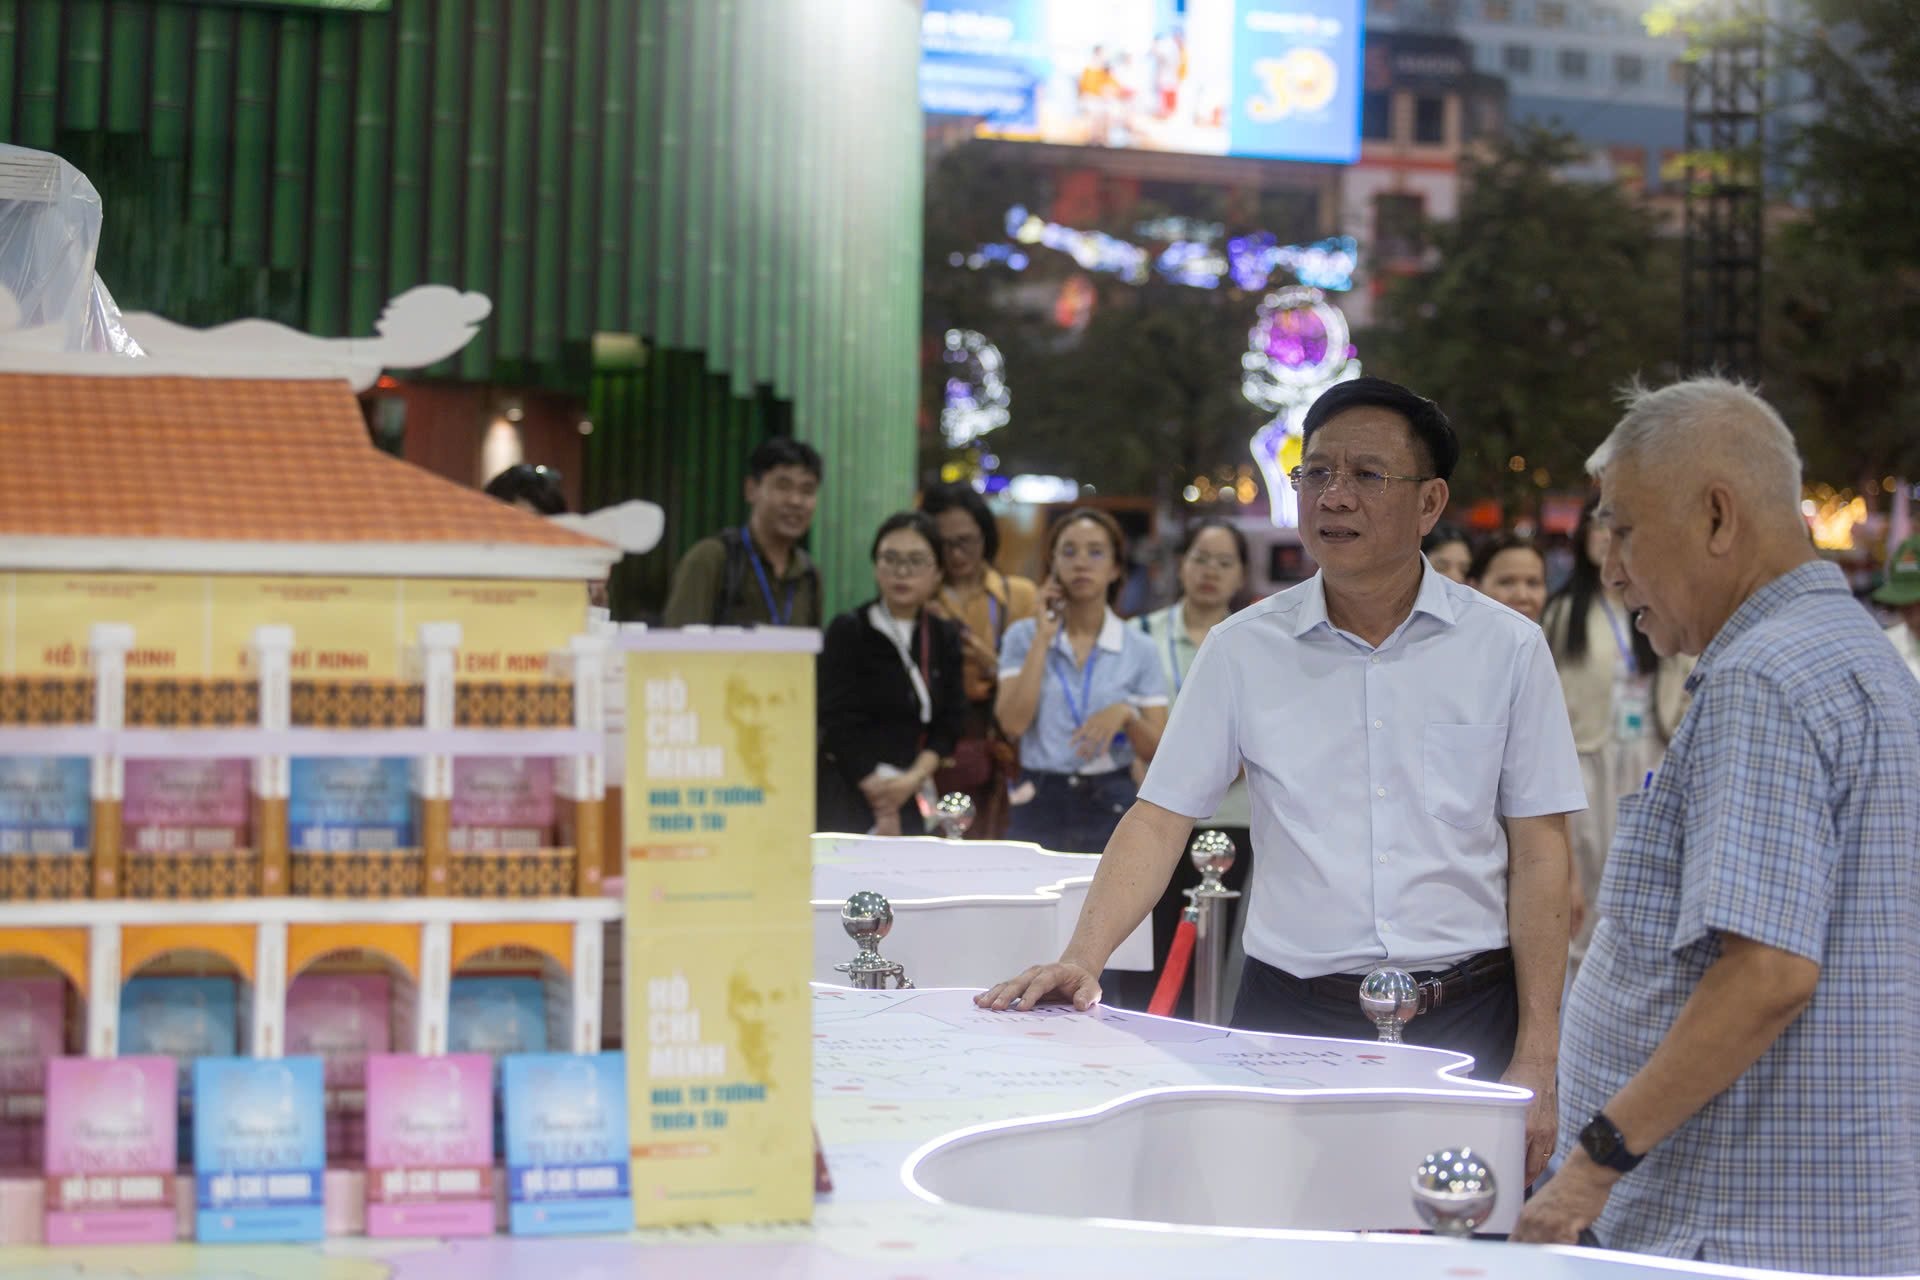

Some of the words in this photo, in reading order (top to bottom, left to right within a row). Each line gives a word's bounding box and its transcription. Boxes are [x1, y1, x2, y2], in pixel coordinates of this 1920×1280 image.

[645, 668, 688, 712] HỒ
[647, 746, 725, 779] MINH
[648, 968, 690, 1010] HỒ
[649, 1043, 727, 1078] MINH
